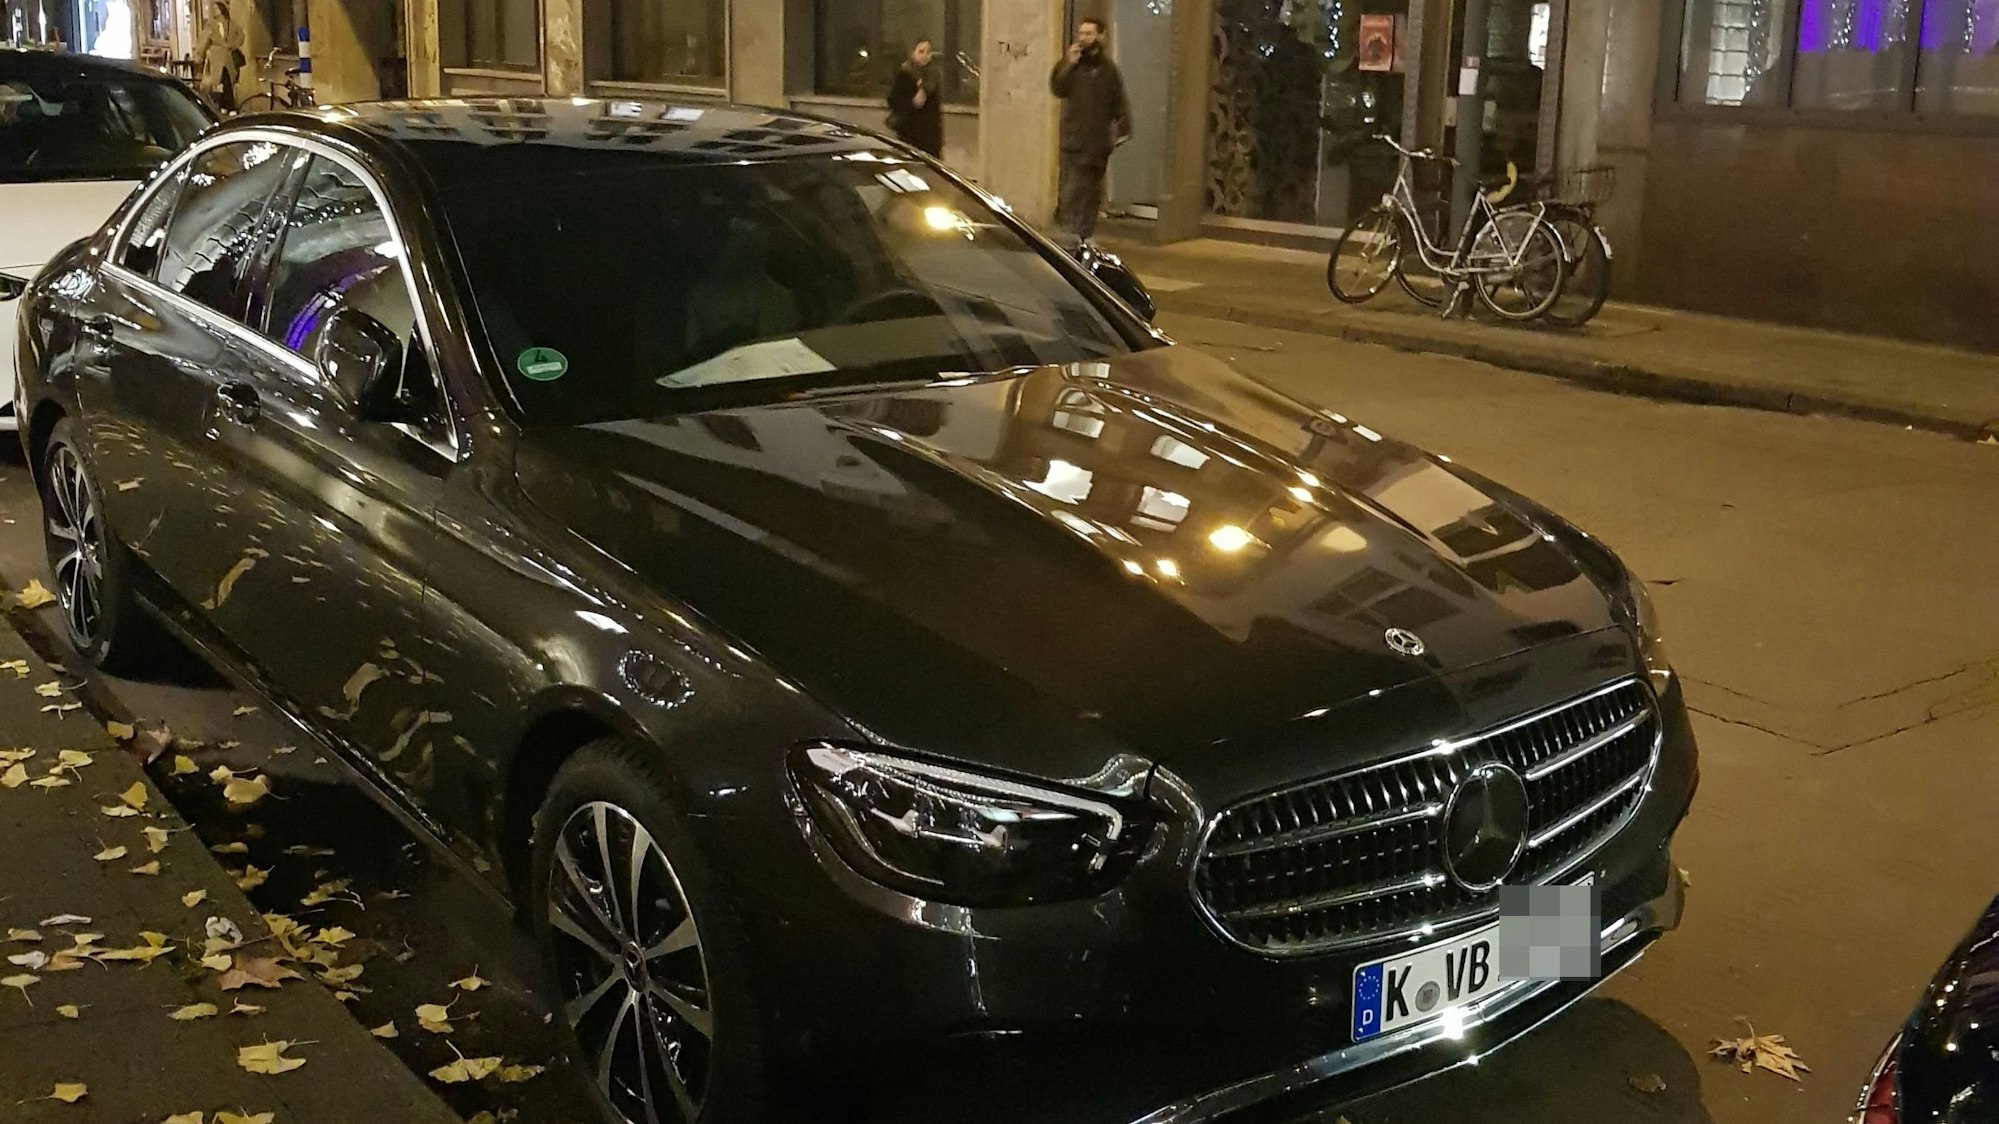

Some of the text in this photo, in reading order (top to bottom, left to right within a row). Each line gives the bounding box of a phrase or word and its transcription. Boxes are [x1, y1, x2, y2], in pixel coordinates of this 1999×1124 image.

[1385, 939, 1491, 1022] K VB
[1362, 1009, 1374, 1026] D
